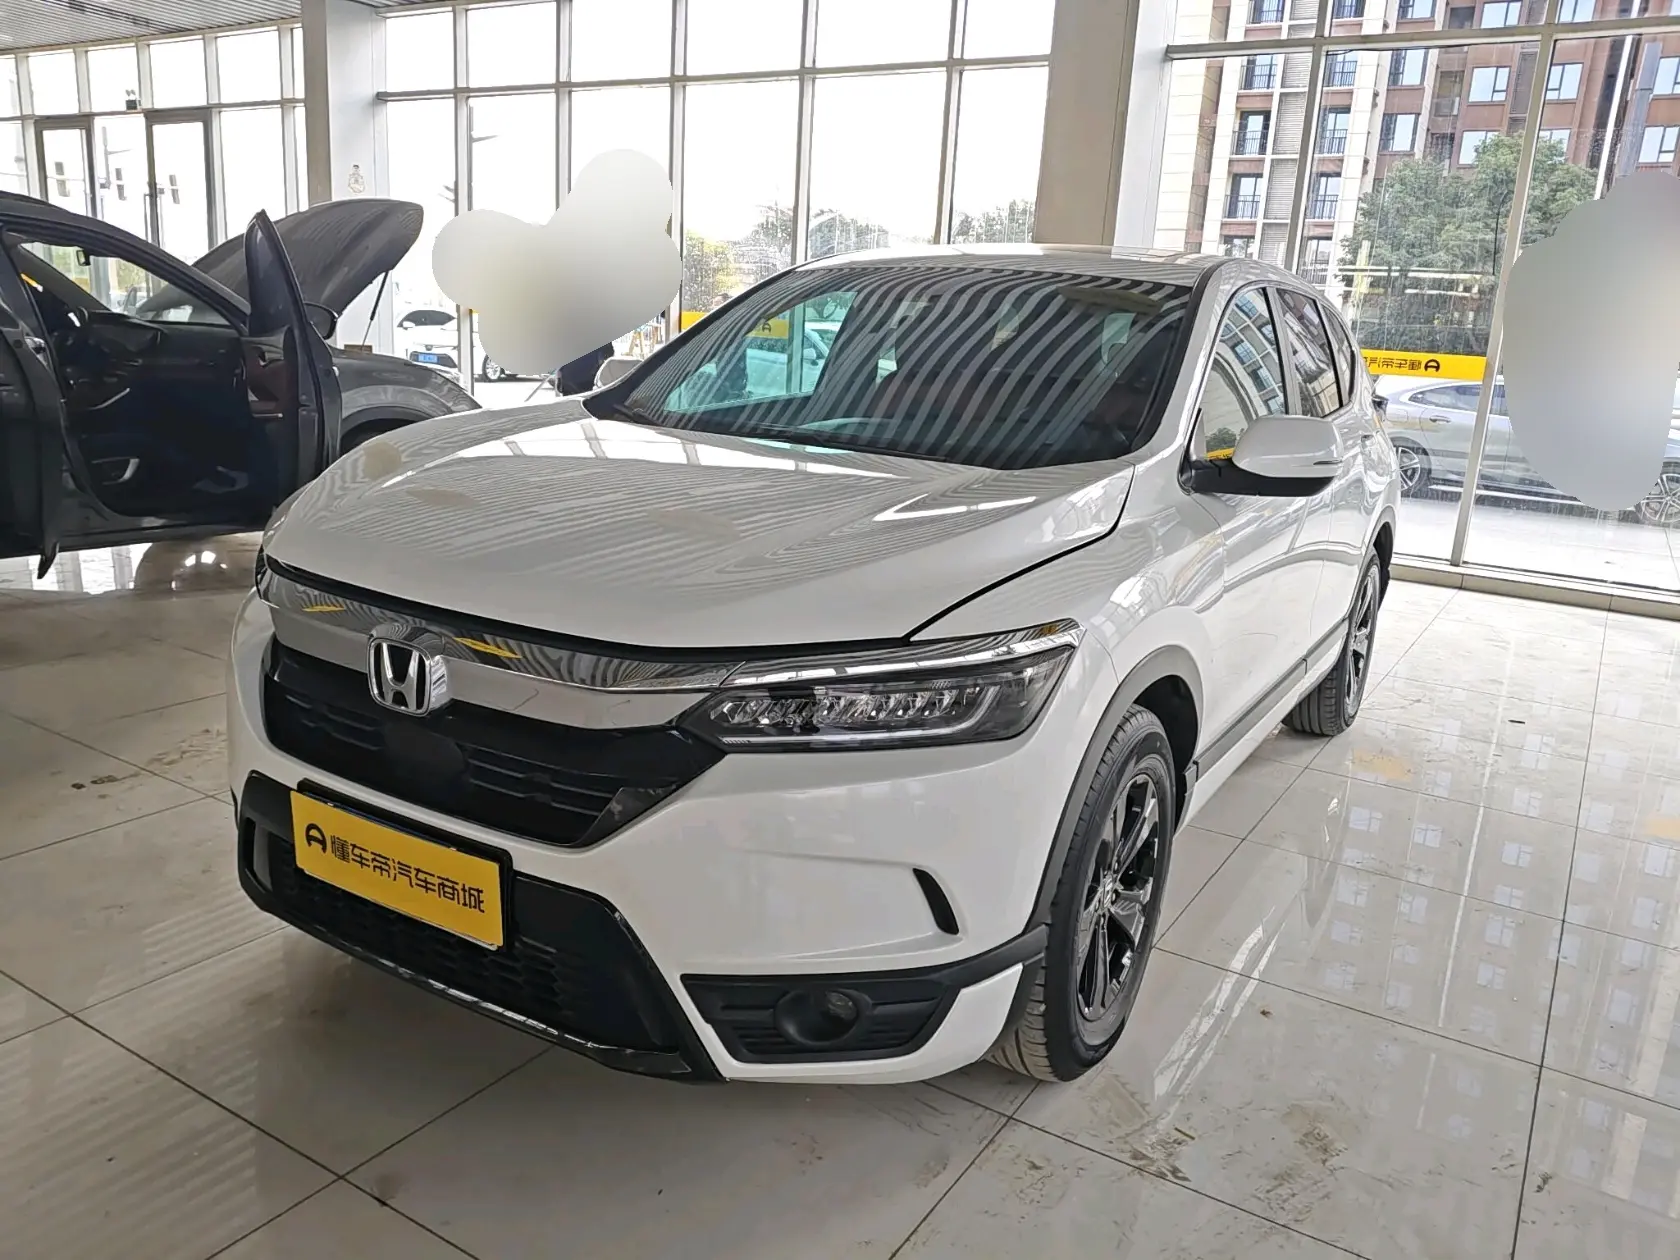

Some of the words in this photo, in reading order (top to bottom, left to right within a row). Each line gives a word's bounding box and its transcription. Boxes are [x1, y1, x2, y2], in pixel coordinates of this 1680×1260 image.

[330, 834, 485, 914] 懂车帝汽车商城
